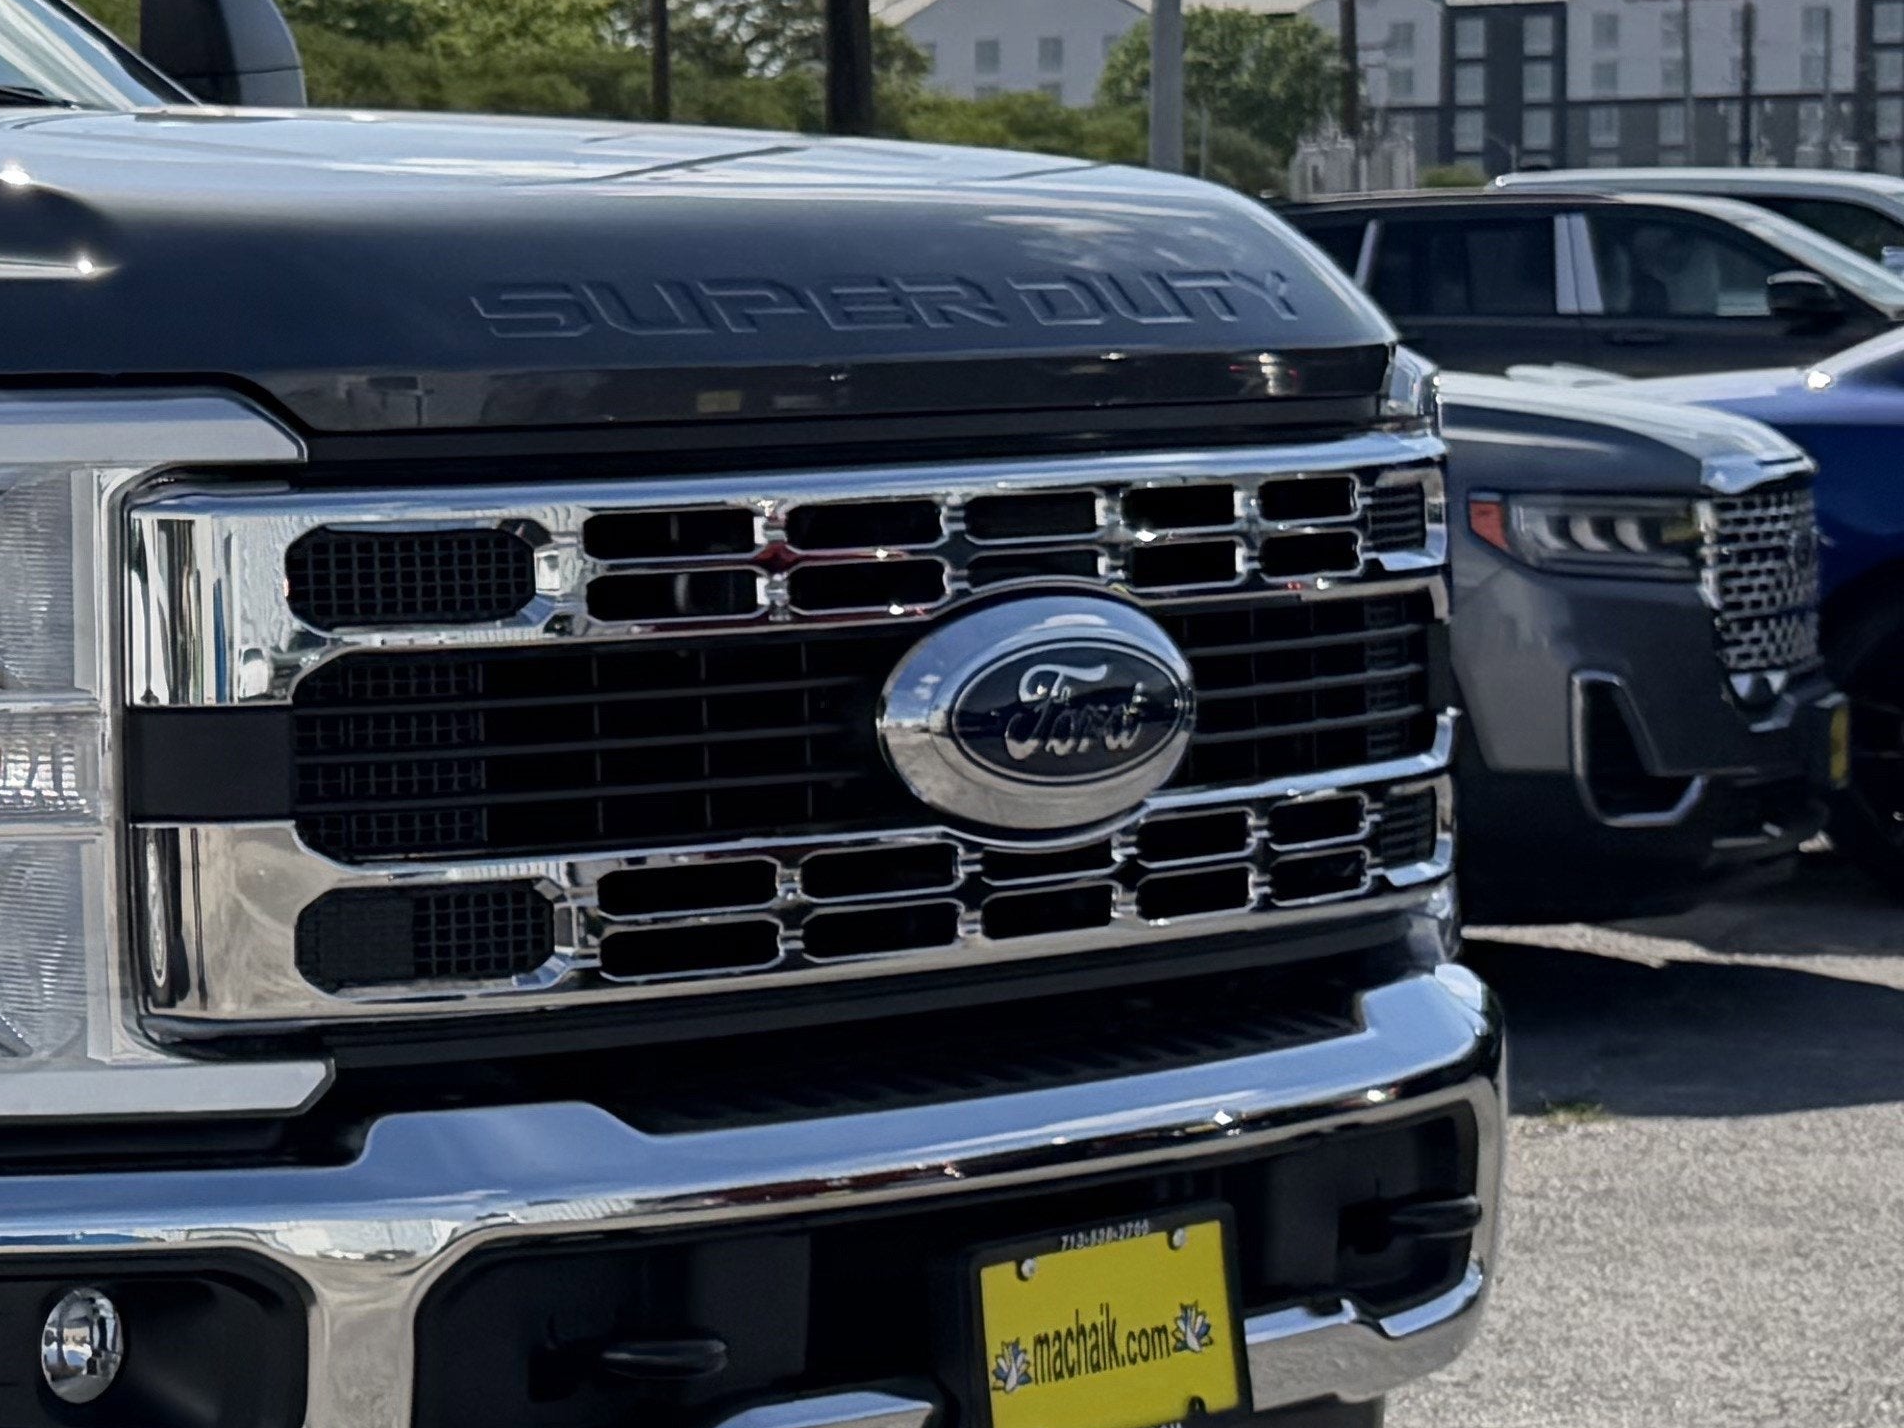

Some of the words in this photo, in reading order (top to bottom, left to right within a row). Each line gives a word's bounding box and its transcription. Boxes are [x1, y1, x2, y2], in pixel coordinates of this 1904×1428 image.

[470, 276, 1008, 339] SUPER
[1005, 270, 1298, 326] DUTY
[1005, 663, 1144, 760] Ford
[1033, 1303, 1171, 1386] machaik.com
